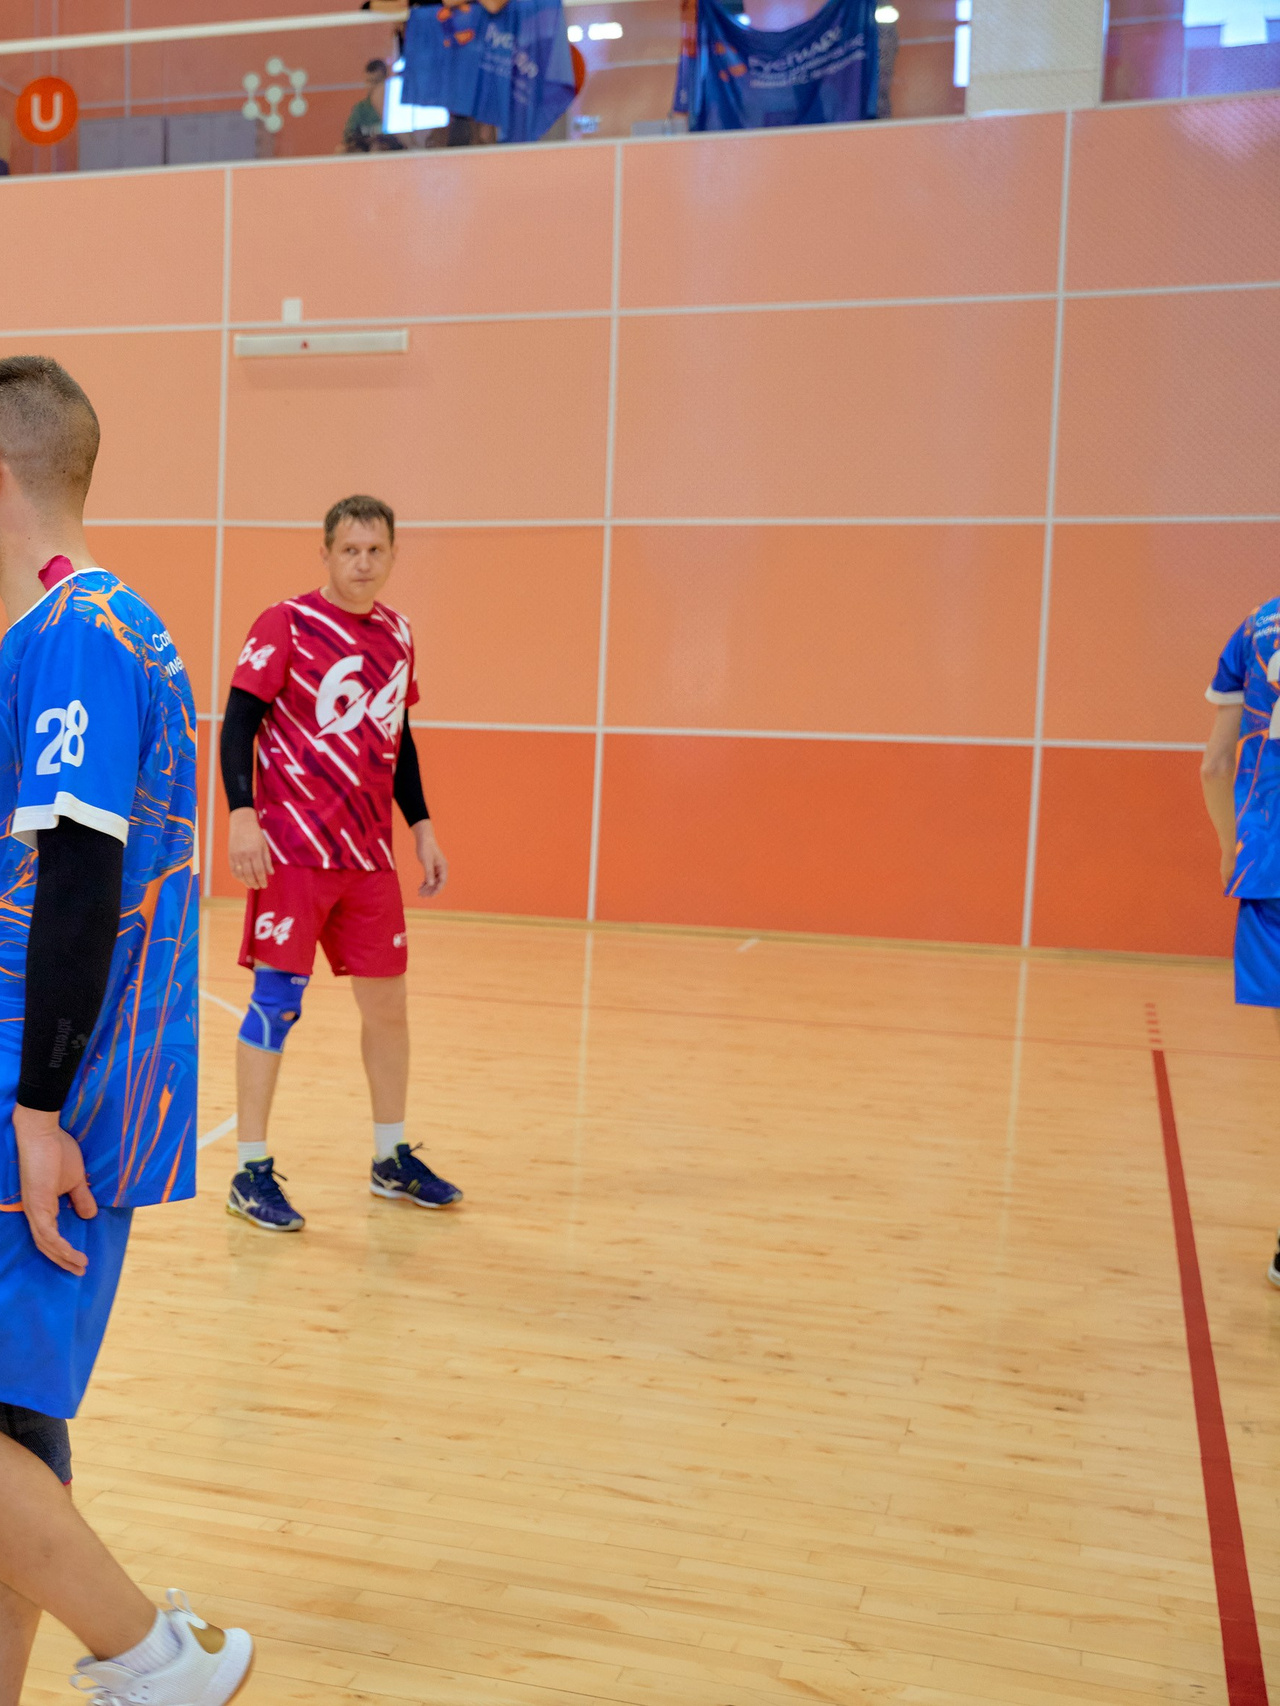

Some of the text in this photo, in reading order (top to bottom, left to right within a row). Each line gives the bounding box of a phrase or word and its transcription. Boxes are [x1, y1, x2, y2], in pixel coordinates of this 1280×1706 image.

[30, 92, 63, 132] U
[237, 637, 277, 672] 64
[314, 655, 408, 742] 64
[35, 699, 89, 776] 28
[254, 911, 295, 946] 64
